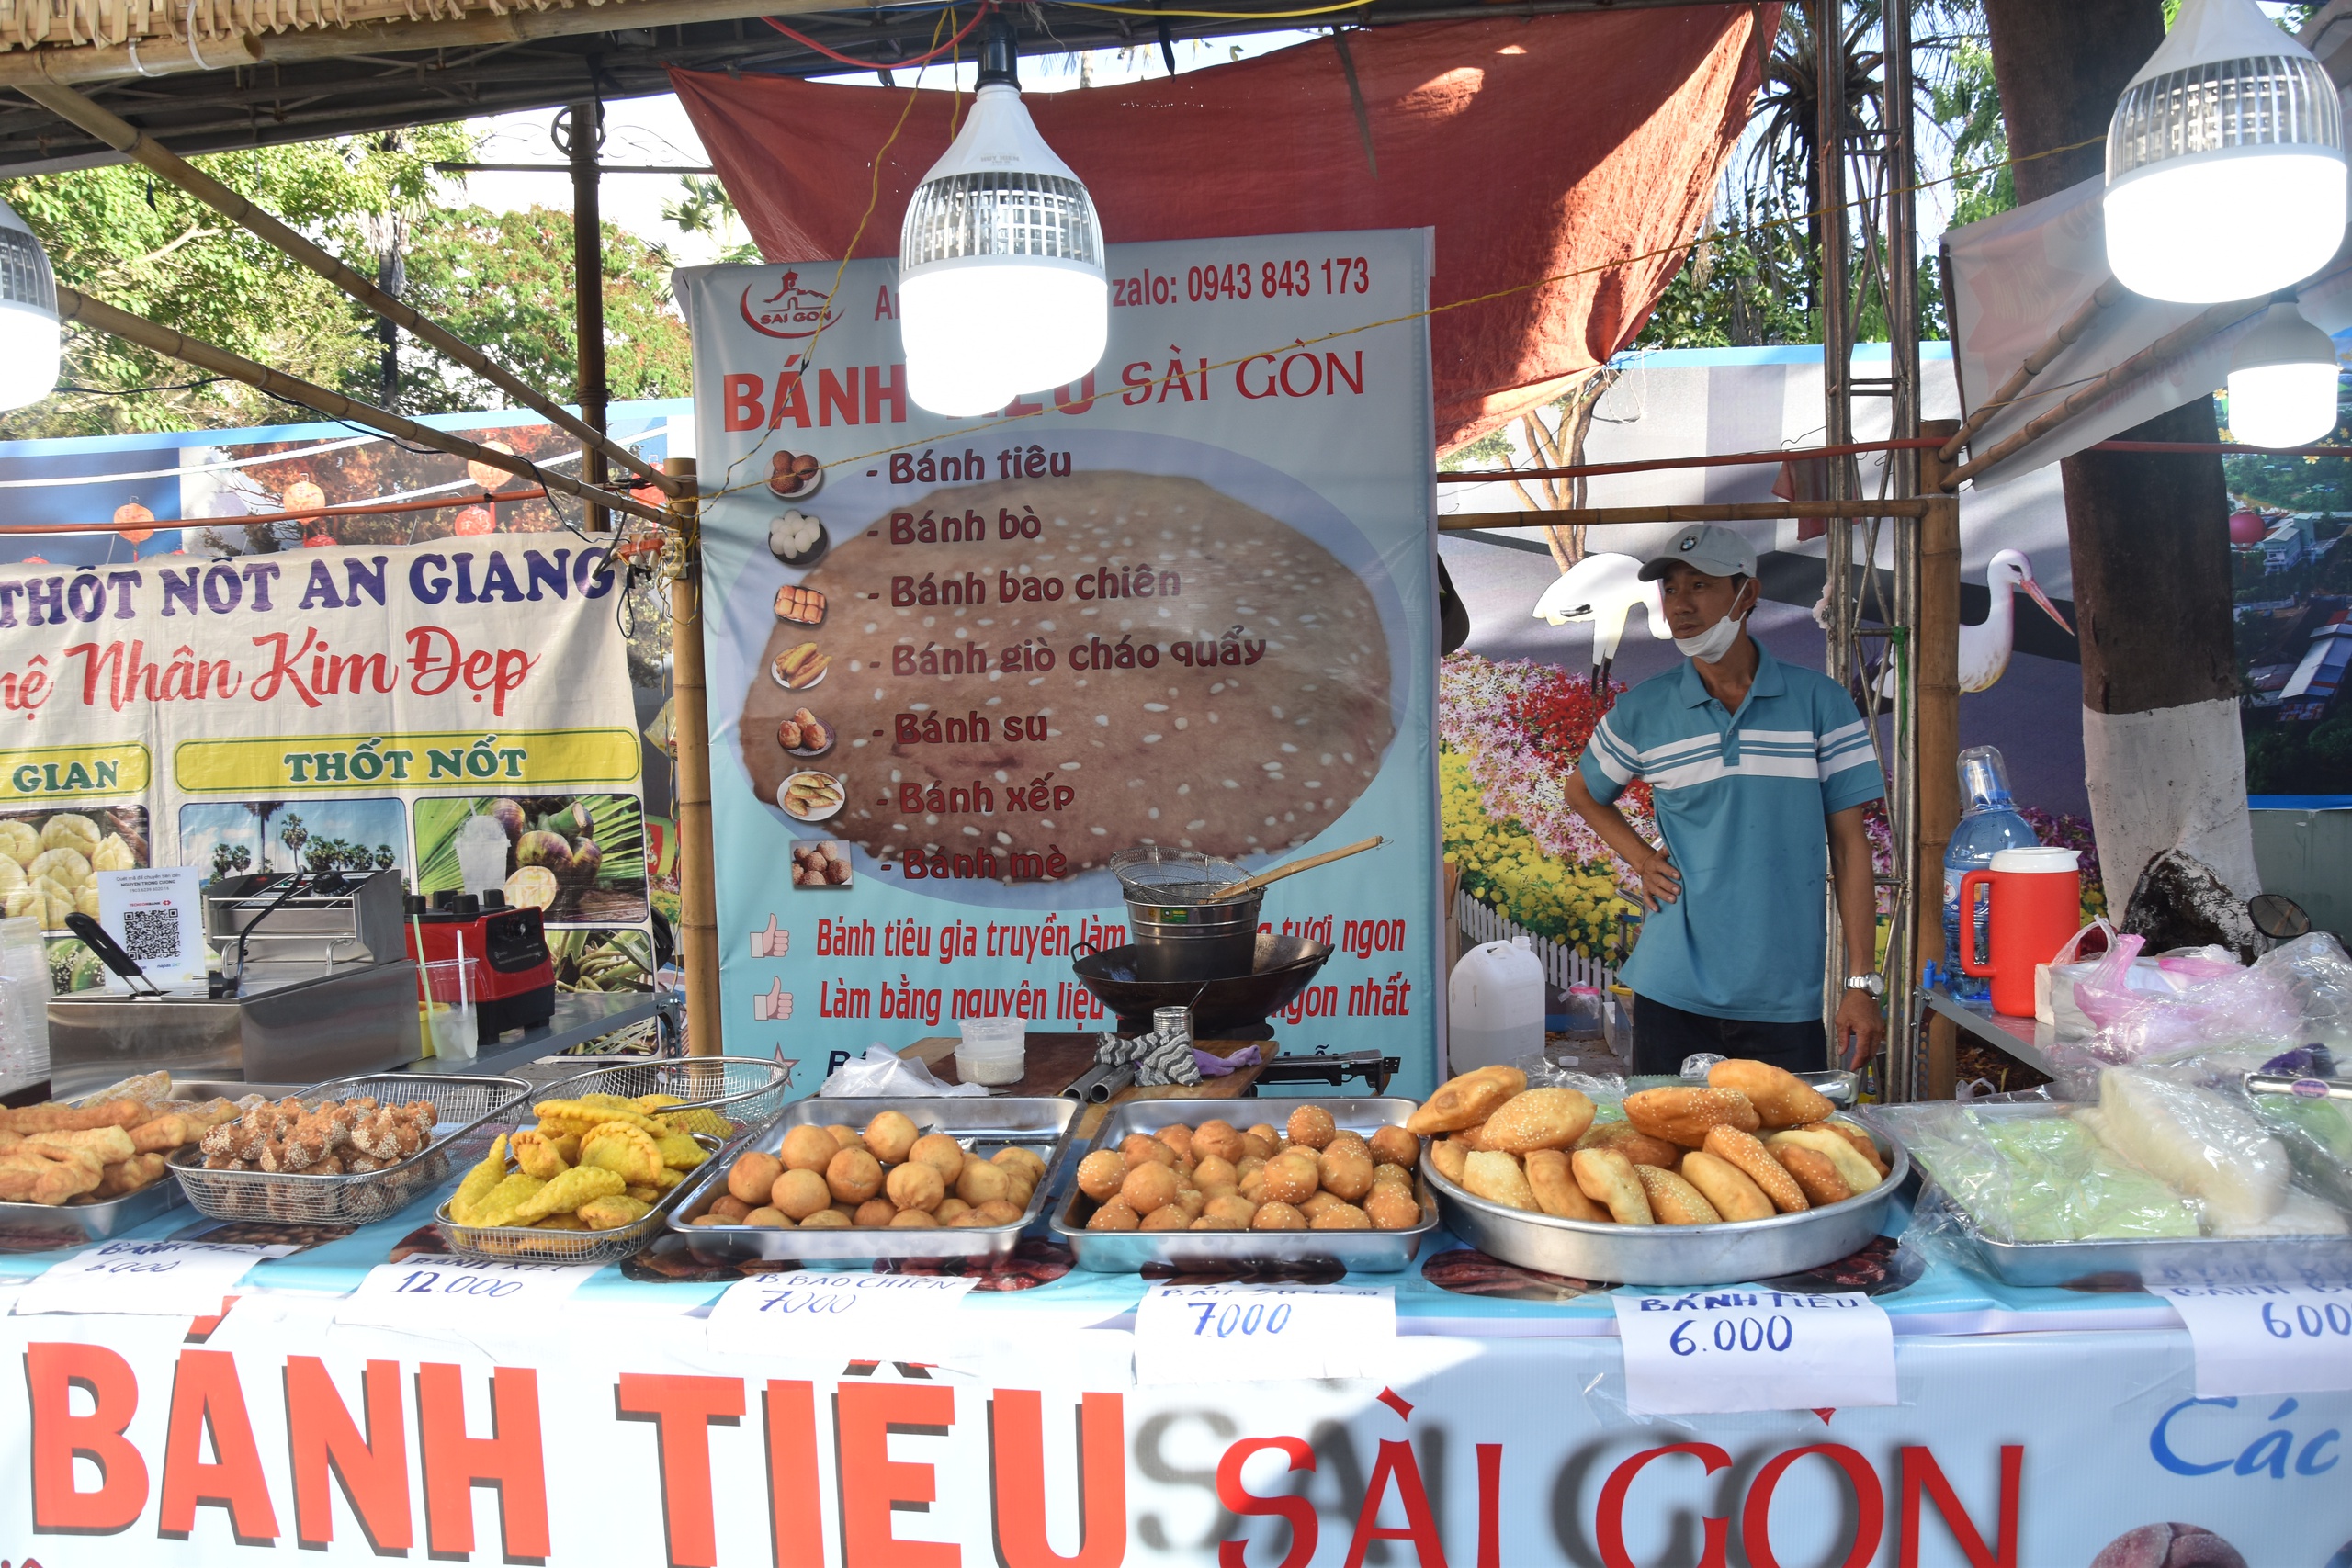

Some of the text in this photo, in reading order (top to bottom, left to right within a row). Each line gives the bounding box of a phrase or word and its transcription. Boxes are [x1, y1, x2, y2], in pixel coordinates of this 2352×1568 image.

[1112, 268, 1177, 307] zalo:
[1187, 263, 1252, 302] 0943
[1261, 260, 1311, 299] 843
[1320, 257, 1370, 295] 173
[760, 313, 789, 325] SAI
[724, 354, 907, 433] BÁNH
[1121, 344, 1209, 406] SÀI
[1235, 337, 1364, 400] GÒN
[889, 449, 986, 485] Bánh
[998, 445, 1072, 479] tiêu
[889, 510, 986, 545] Bánh
[999, 505, 1042, 540] bò
[297, 555, 389, 610] AN
[408, 547, 616, 606] GIANG
[890, 571, 986, 607] Bánh
[999, 570, 1064, 603] bao
[1075, 563, 1182, 600] chiên
[63, 639, 243, 712] Nhân
[250, 626, 400, 709] Kim
[405, 625, 541, 717] Đẹp
[891, 641, 988, 677] Bánh
[1000, 637, 1056, 673] giò
[1069, 635, 1160, 671] cháo
[1170, 625, 1268, 669] quẩy
[894, 711, 990, 745] Bánh
[1003, 715, 1048, 742] su
[11, 759, 119, 794] GIAN
[283, 734, 527, 784] THỐT NỐT
[899, 781, 995, 814] Bánh
[1005, 772, 1075, 812] xếp
[902, 847, 998, 880] Bánh
[1011, 844, 1068, 879] mè
[817, 916, 875, 957] Bánh
[884, 917, 931, 957] tiêu
[939, 919, 978, 964] gia
[986, 912, 1070, 964] truyền
[1080, 915, 1125, 956] làm
[1342, 919, 1407, 959] ngon
[820, 977, 871, 1019] Làm
[879, 974, 943, 1027] bằng
[1057, 981, 1104, 1031] liệu
[1348, 971, 1412, 1017] nhất
[391, 1270, 524, 1298] 12.000
[787, 1274, 852, 1287] BAO
[1640, 1292, 1758, 1312] BÁNH
[2261, 1302, 2352, 1339] 600
[1669, 1315, 1792, 1357] 6.000
[23, 1296, 2341, 1568] BÁNH TIÊU SÀI GÒN Các
